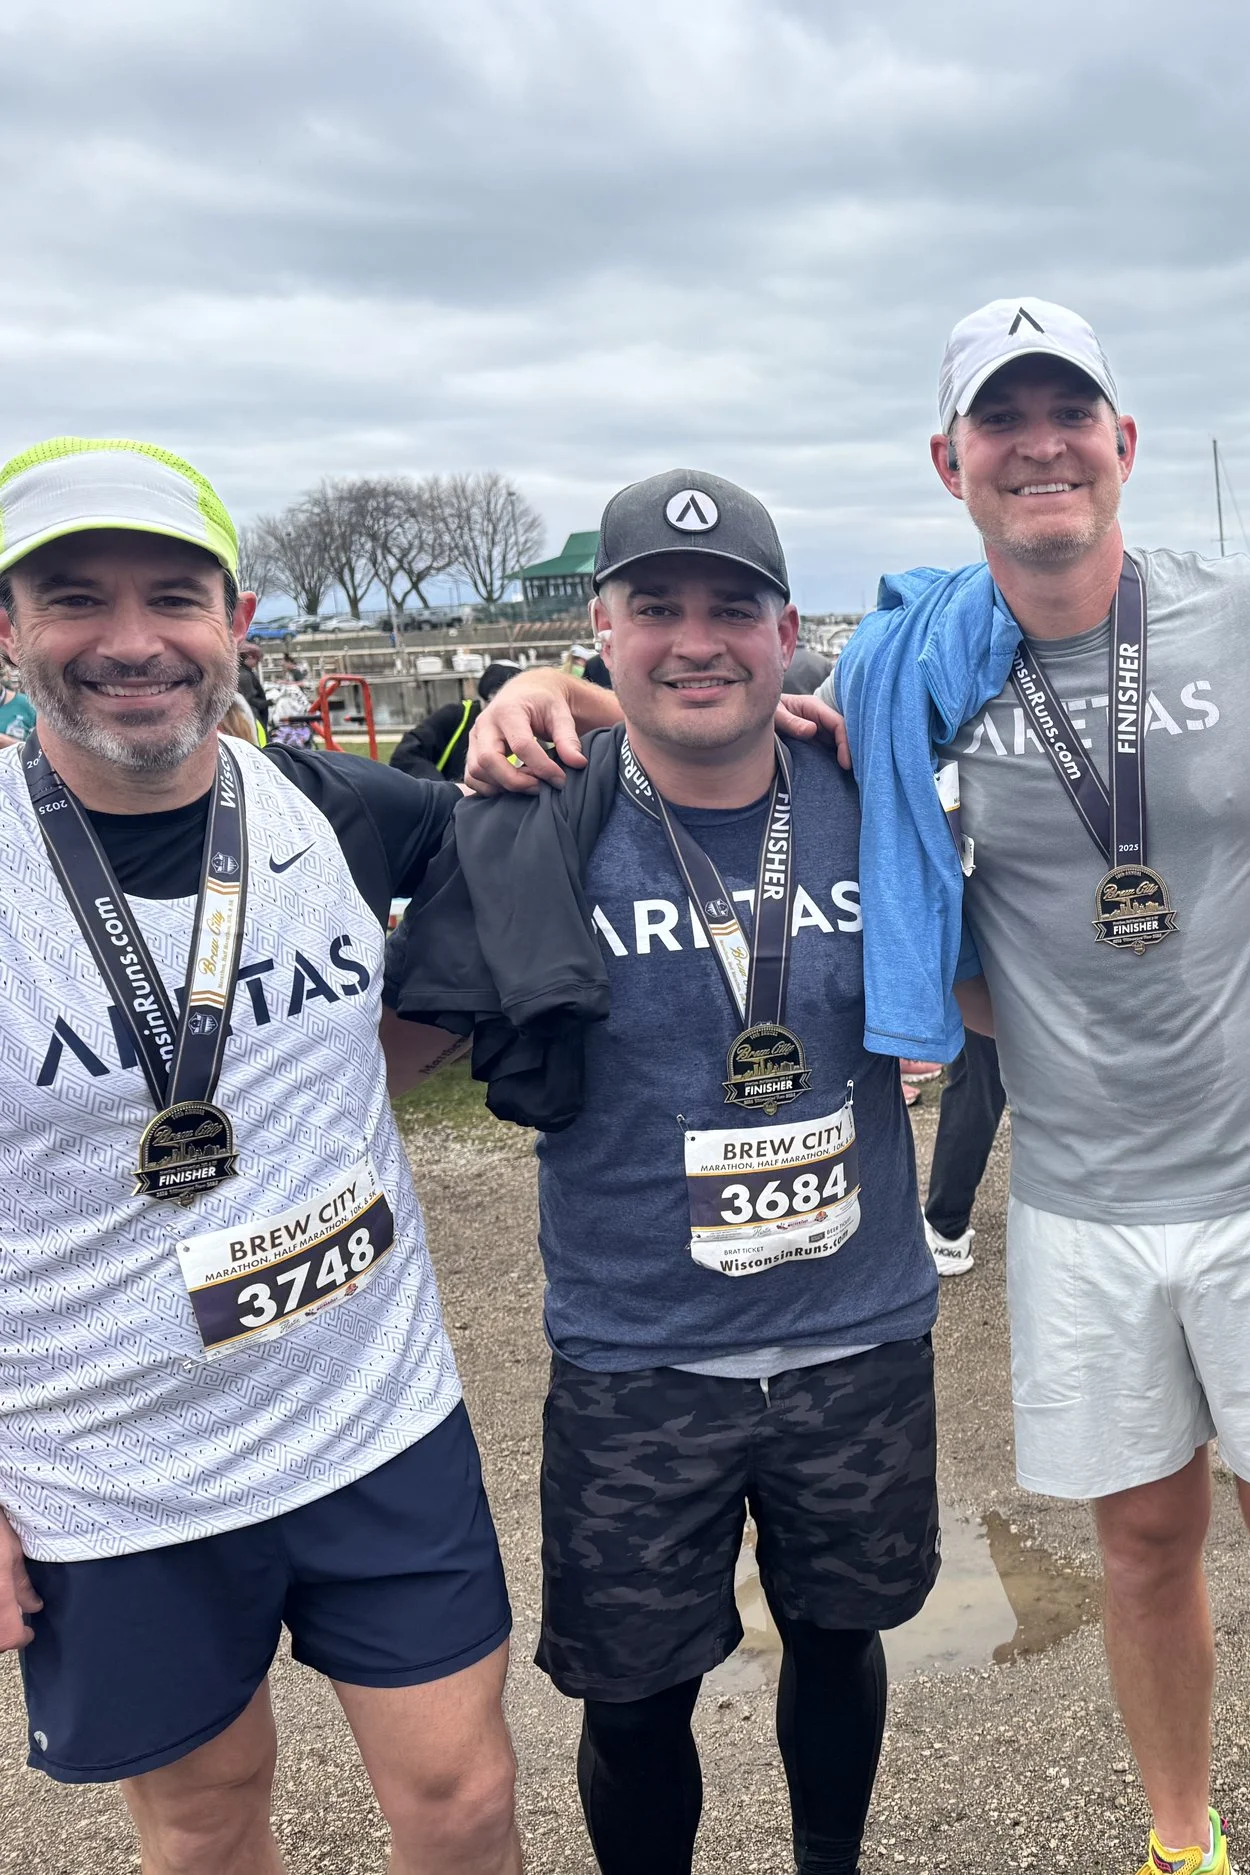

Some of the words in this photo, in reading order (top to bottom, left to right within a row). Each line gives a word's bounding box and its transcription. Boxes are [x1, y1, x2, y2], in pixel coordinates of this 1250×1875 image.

[1117, 643, 1140, 754] FINISHER
[38, 799, 68, 815] 2025
[1118, 843, 1139, 852] 2025
[206, 908, 226, 936] City
[1113, 921, 1160, 935] FINISHER
[198, 937, 220, 977] Brew
[744, 1080, 793, 1096] FINISHER
[723, 1136, 796, 1161] BREW
[802, 1120, 843, 1150] CITY
[700, 1160, 756, 1173] MARATHON,
[757, 1158, 780, 1168] HALF
[781, 1148, 831, 1165] MARATHON,
[158, 1166, 217, 1187] FINISHER
[720, 1162, 848, 1224] 3684
[229, 1213, 312, 1263] BREW
[318, 1181, 358, 1224] CITY
[204, 1255, 272, 1283] MARATHON,
[274, 1243, 298, 1260] HALF
[299, 1215, 348, 1247] MARATHON,
[719, 1230, 849, 1273] WisconsinRuns.com
[724, 1247, 741, 1256] BRAT
[741, 1245, 764, 1254] TICKET
[934, 1247, 962, 1259] HOKA
[237, 1227, 375, 1328] 3748
